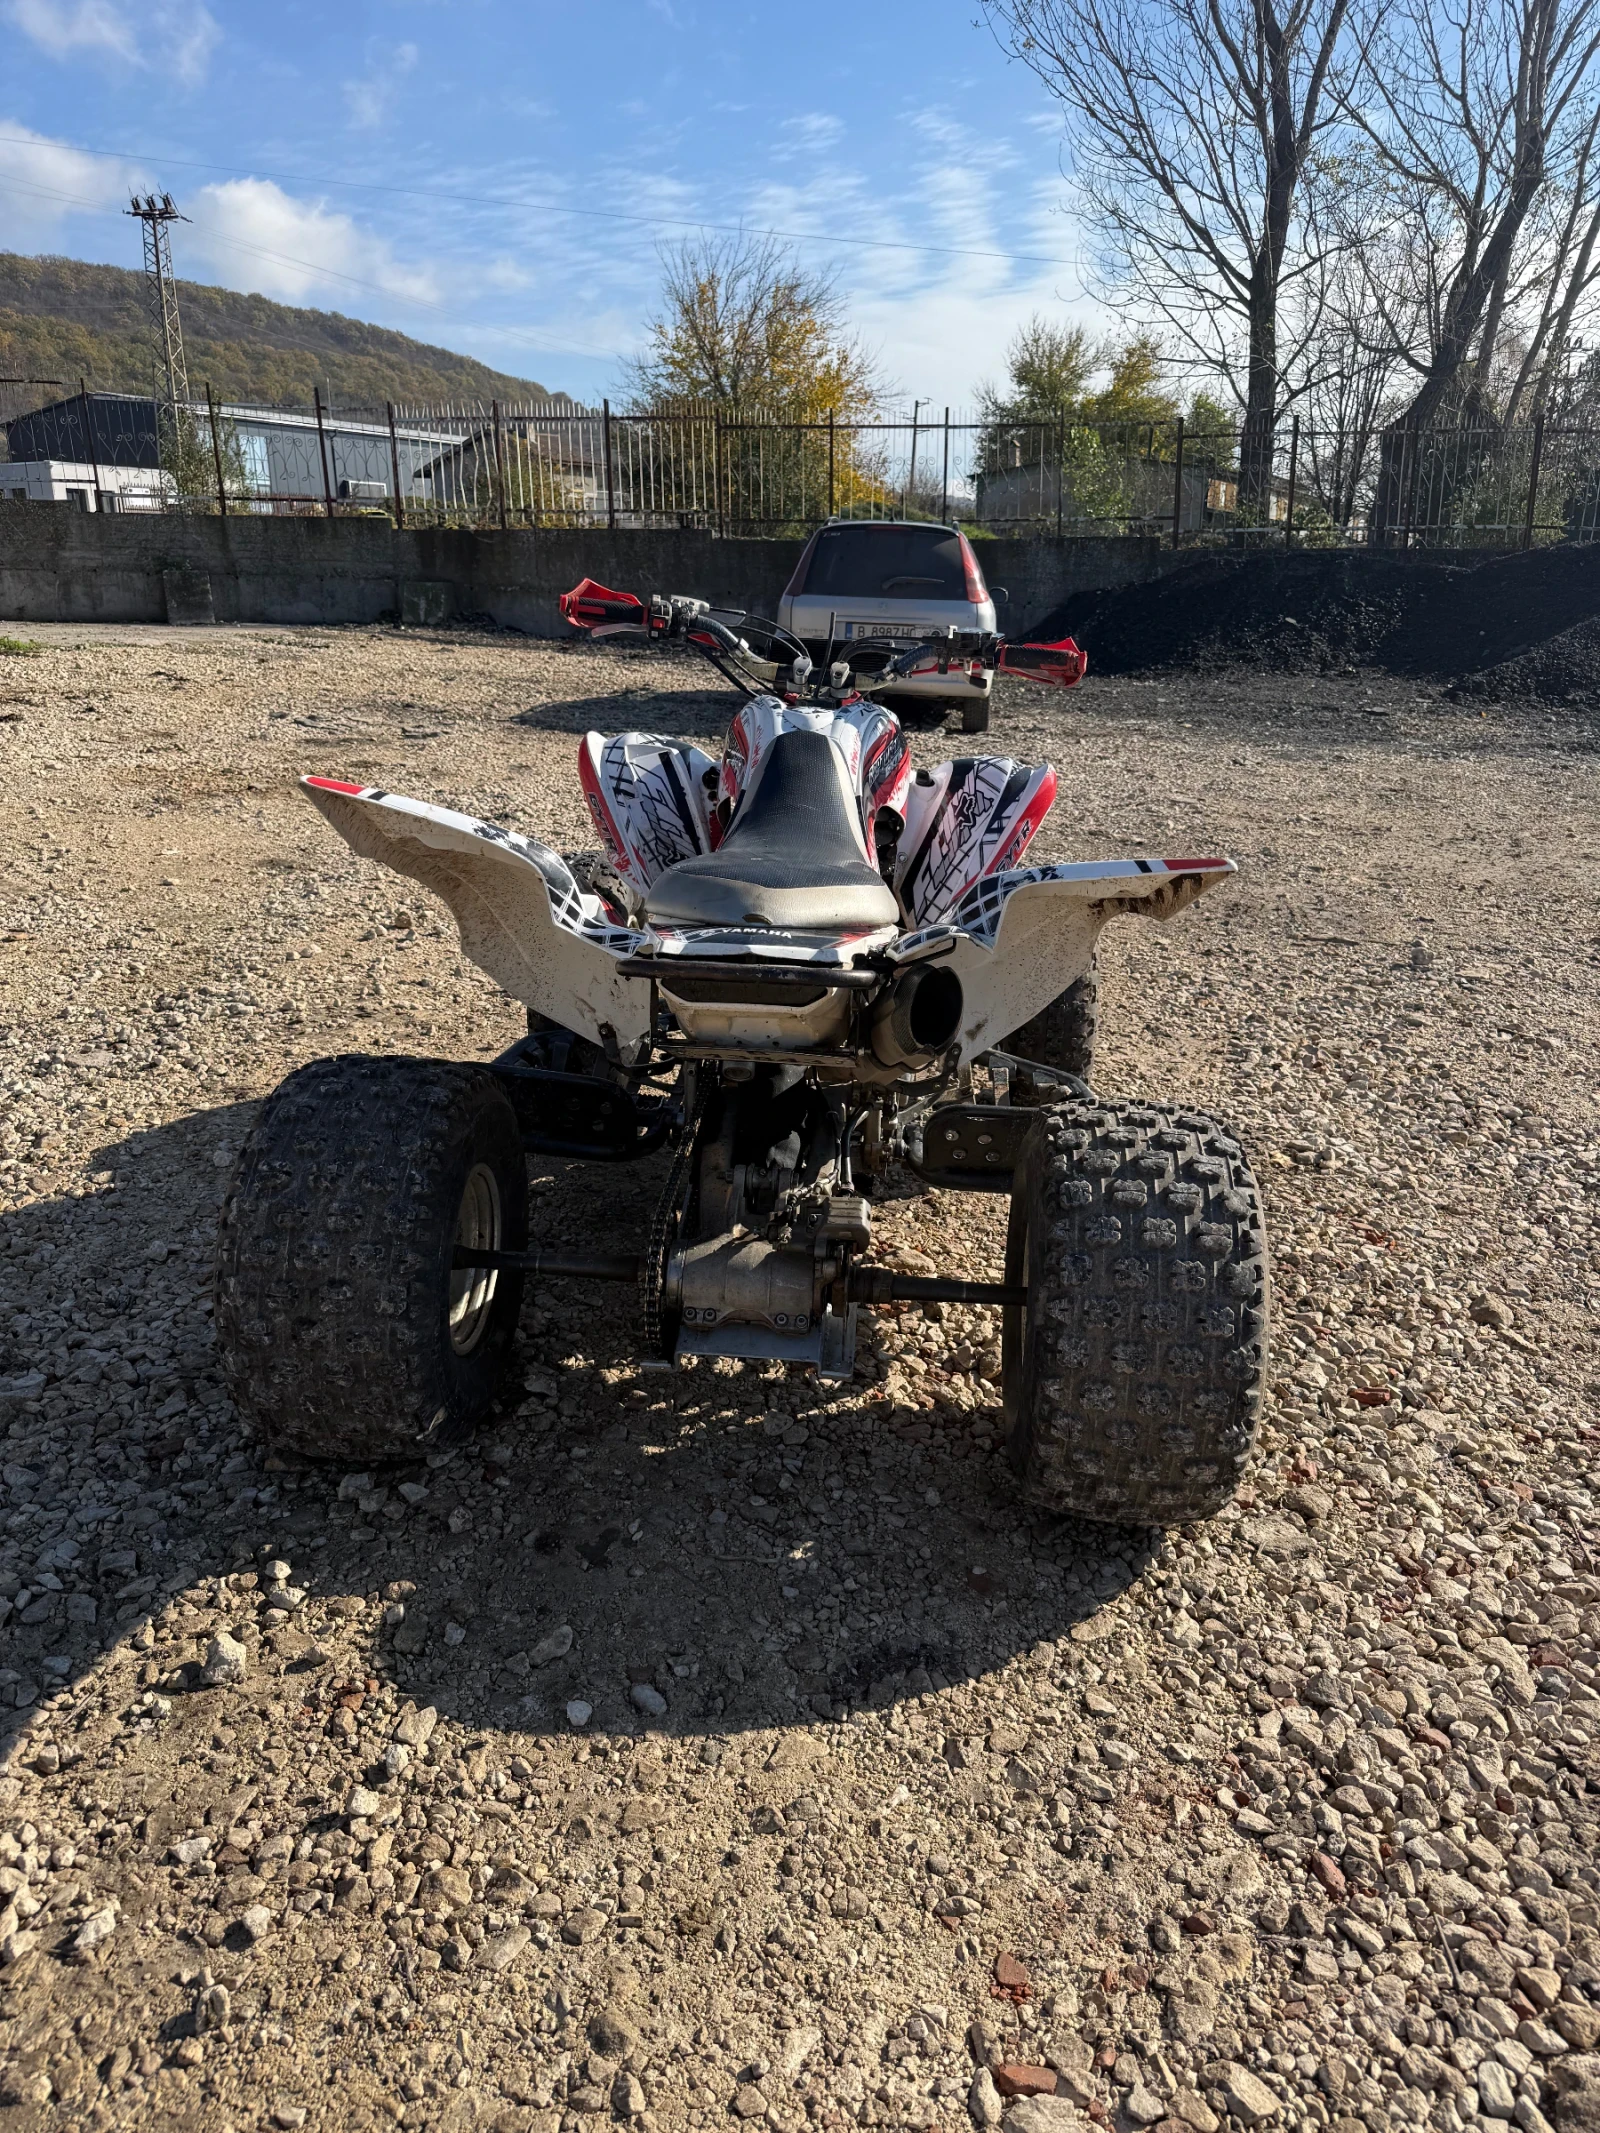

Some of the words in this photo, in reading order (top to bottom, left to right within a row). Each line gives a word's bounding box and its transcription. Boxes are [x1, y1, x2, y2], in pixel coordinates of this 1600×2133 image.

[858, 626, 865, 638] B
[995, 820, 1031, 873] GYTR
[721, 927, 792, 939] YAMAHA
